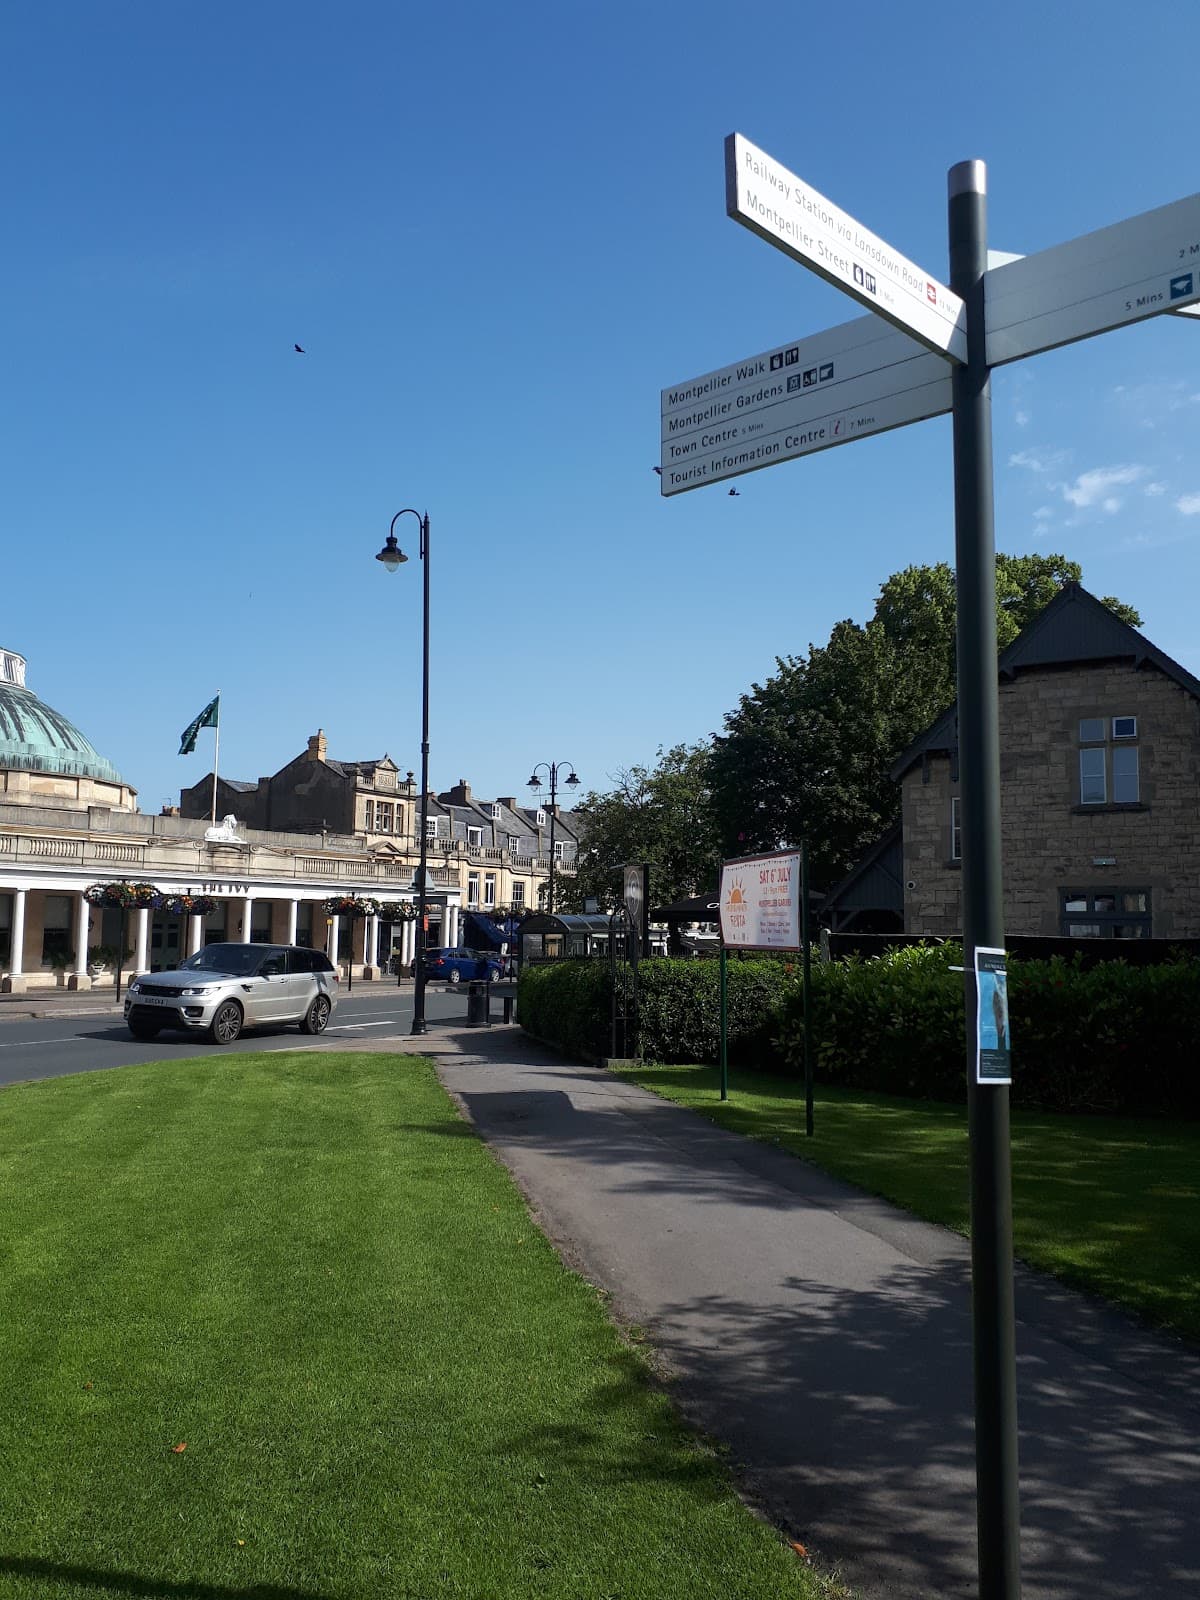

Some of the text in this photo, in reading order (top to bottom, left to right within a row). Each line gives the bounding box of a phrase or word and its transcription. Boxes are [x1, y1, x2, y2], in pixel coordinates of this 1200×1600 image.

[745, 152, 792, 200] Railway
[794, 188, 834, 232] Station
[837, 221, 852, 241] via
[855, 232, 900, 275] Lansdown
[902, 266, 924, 293] Road
[746, 190, 814, 250] Montpellier
[818, 240, 850, 275] Street
[1179, 249, 1184, 258] 2
[1126, 292, 1164, 311] 5 Mins
[668, 362, 766, 406] Montpellier Walk
[668, 384, 783, 432] Montpellier Gardens
[670, 441, 697, 458] Town
[702, 428, 738, 448] Centre
[748, 422, 764, 432] Mins
[670, 465, 707, 485] Tourist
[712, 442, 780, 472] Information
[785, 426, 825, 449] Centre
[857, 416, 876, 427] Mins
[202, 883, 250, 894] THE IVY
[760, 870, 770, 884] SAT
[778, 867, 792, 882] JULY
